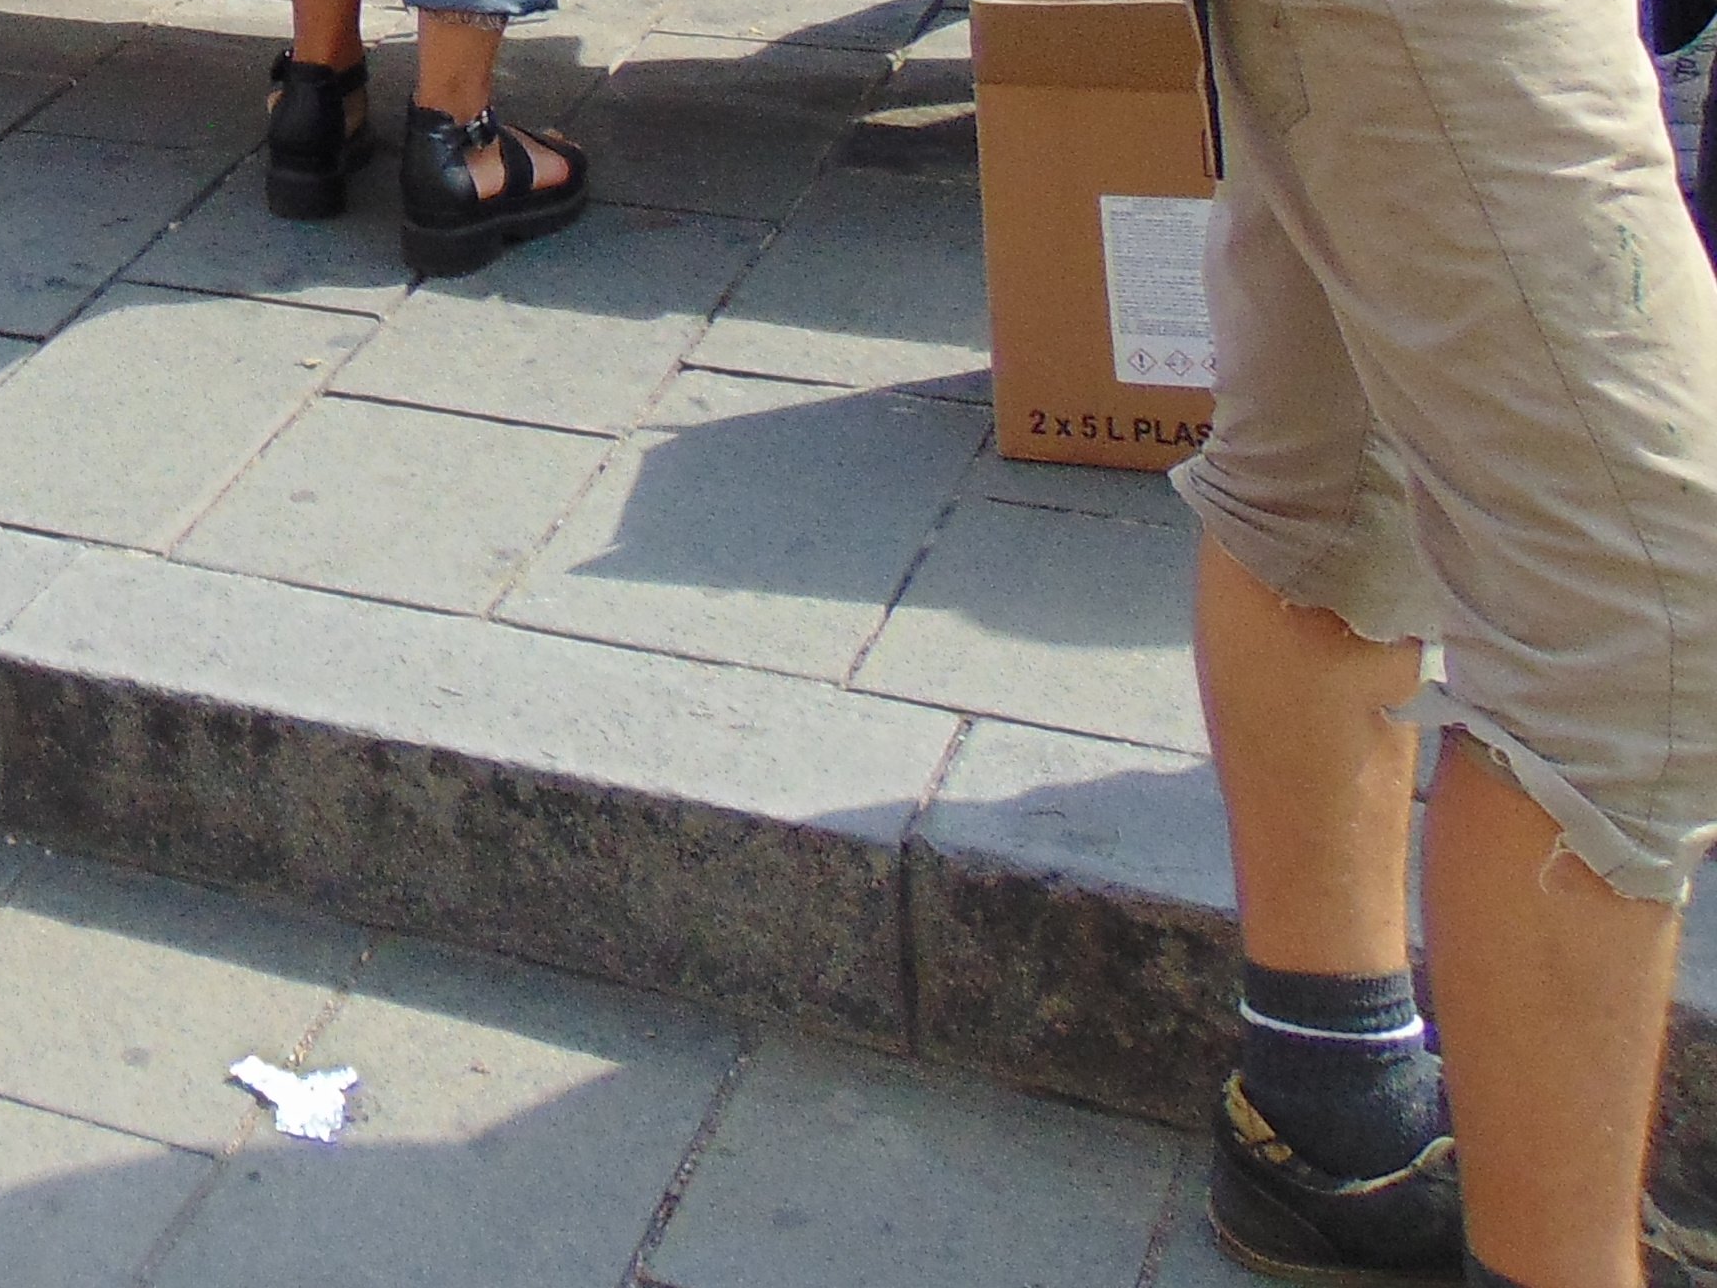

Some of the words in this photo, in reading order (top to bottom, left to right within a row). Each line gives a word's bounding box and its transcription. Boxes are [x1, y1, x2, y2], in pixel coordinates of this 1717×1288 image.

[1029, 409, 1046, 435] 2
[1054, 415, 1073, 437] x
[1082, 414, 1098, 439] 5
[1106, 416, 1125, 442] L
